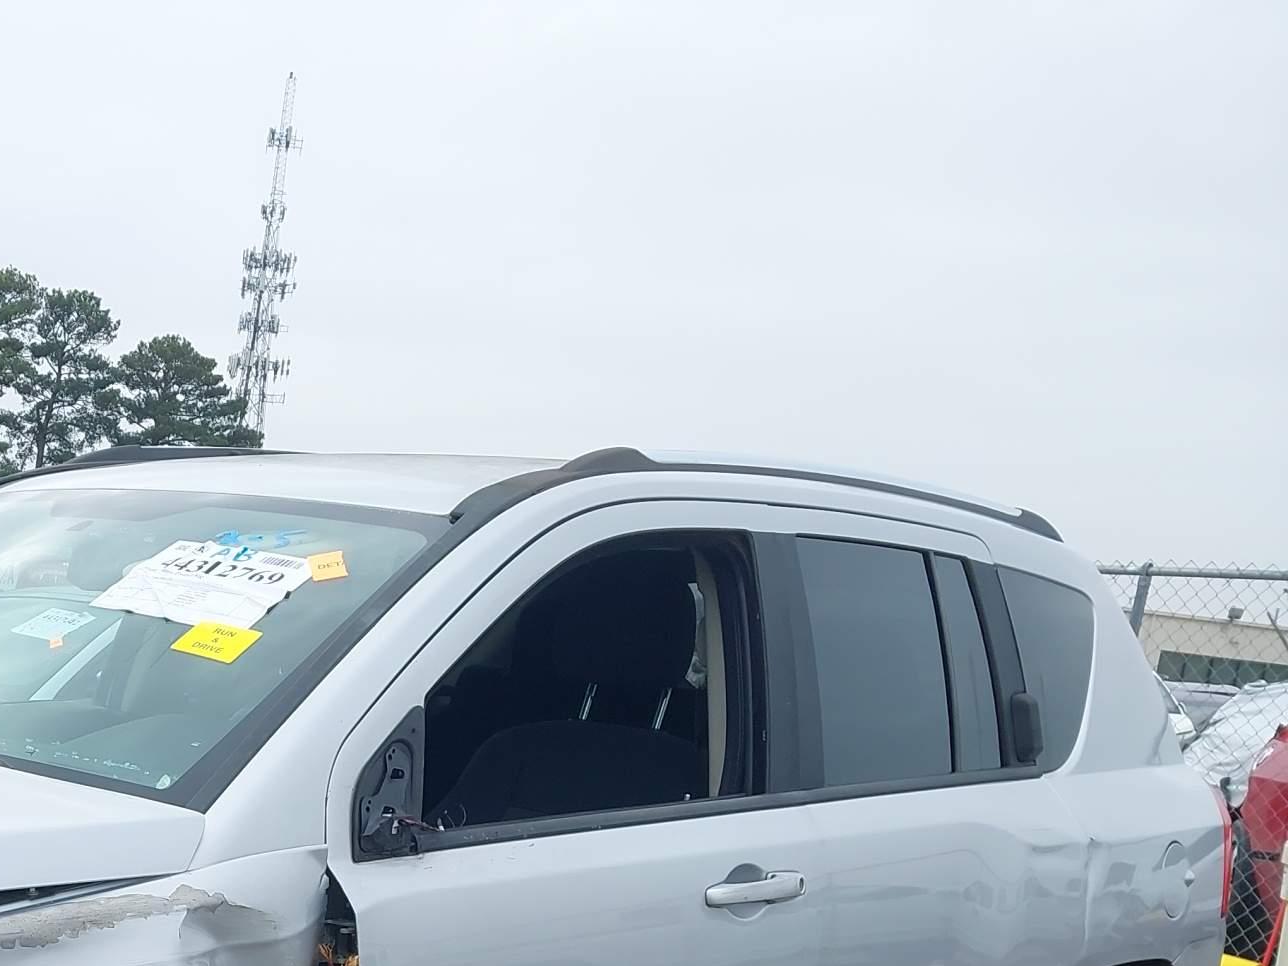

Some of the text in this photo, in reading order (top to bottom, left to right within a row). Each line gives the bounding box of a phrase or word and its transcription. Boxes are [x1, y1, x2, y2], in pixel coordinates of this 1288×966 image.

[162, 556, 285, 585] 44312769
[212, 626, 238, 638] RUN
[192, 640, 225, 655] DRIVE
